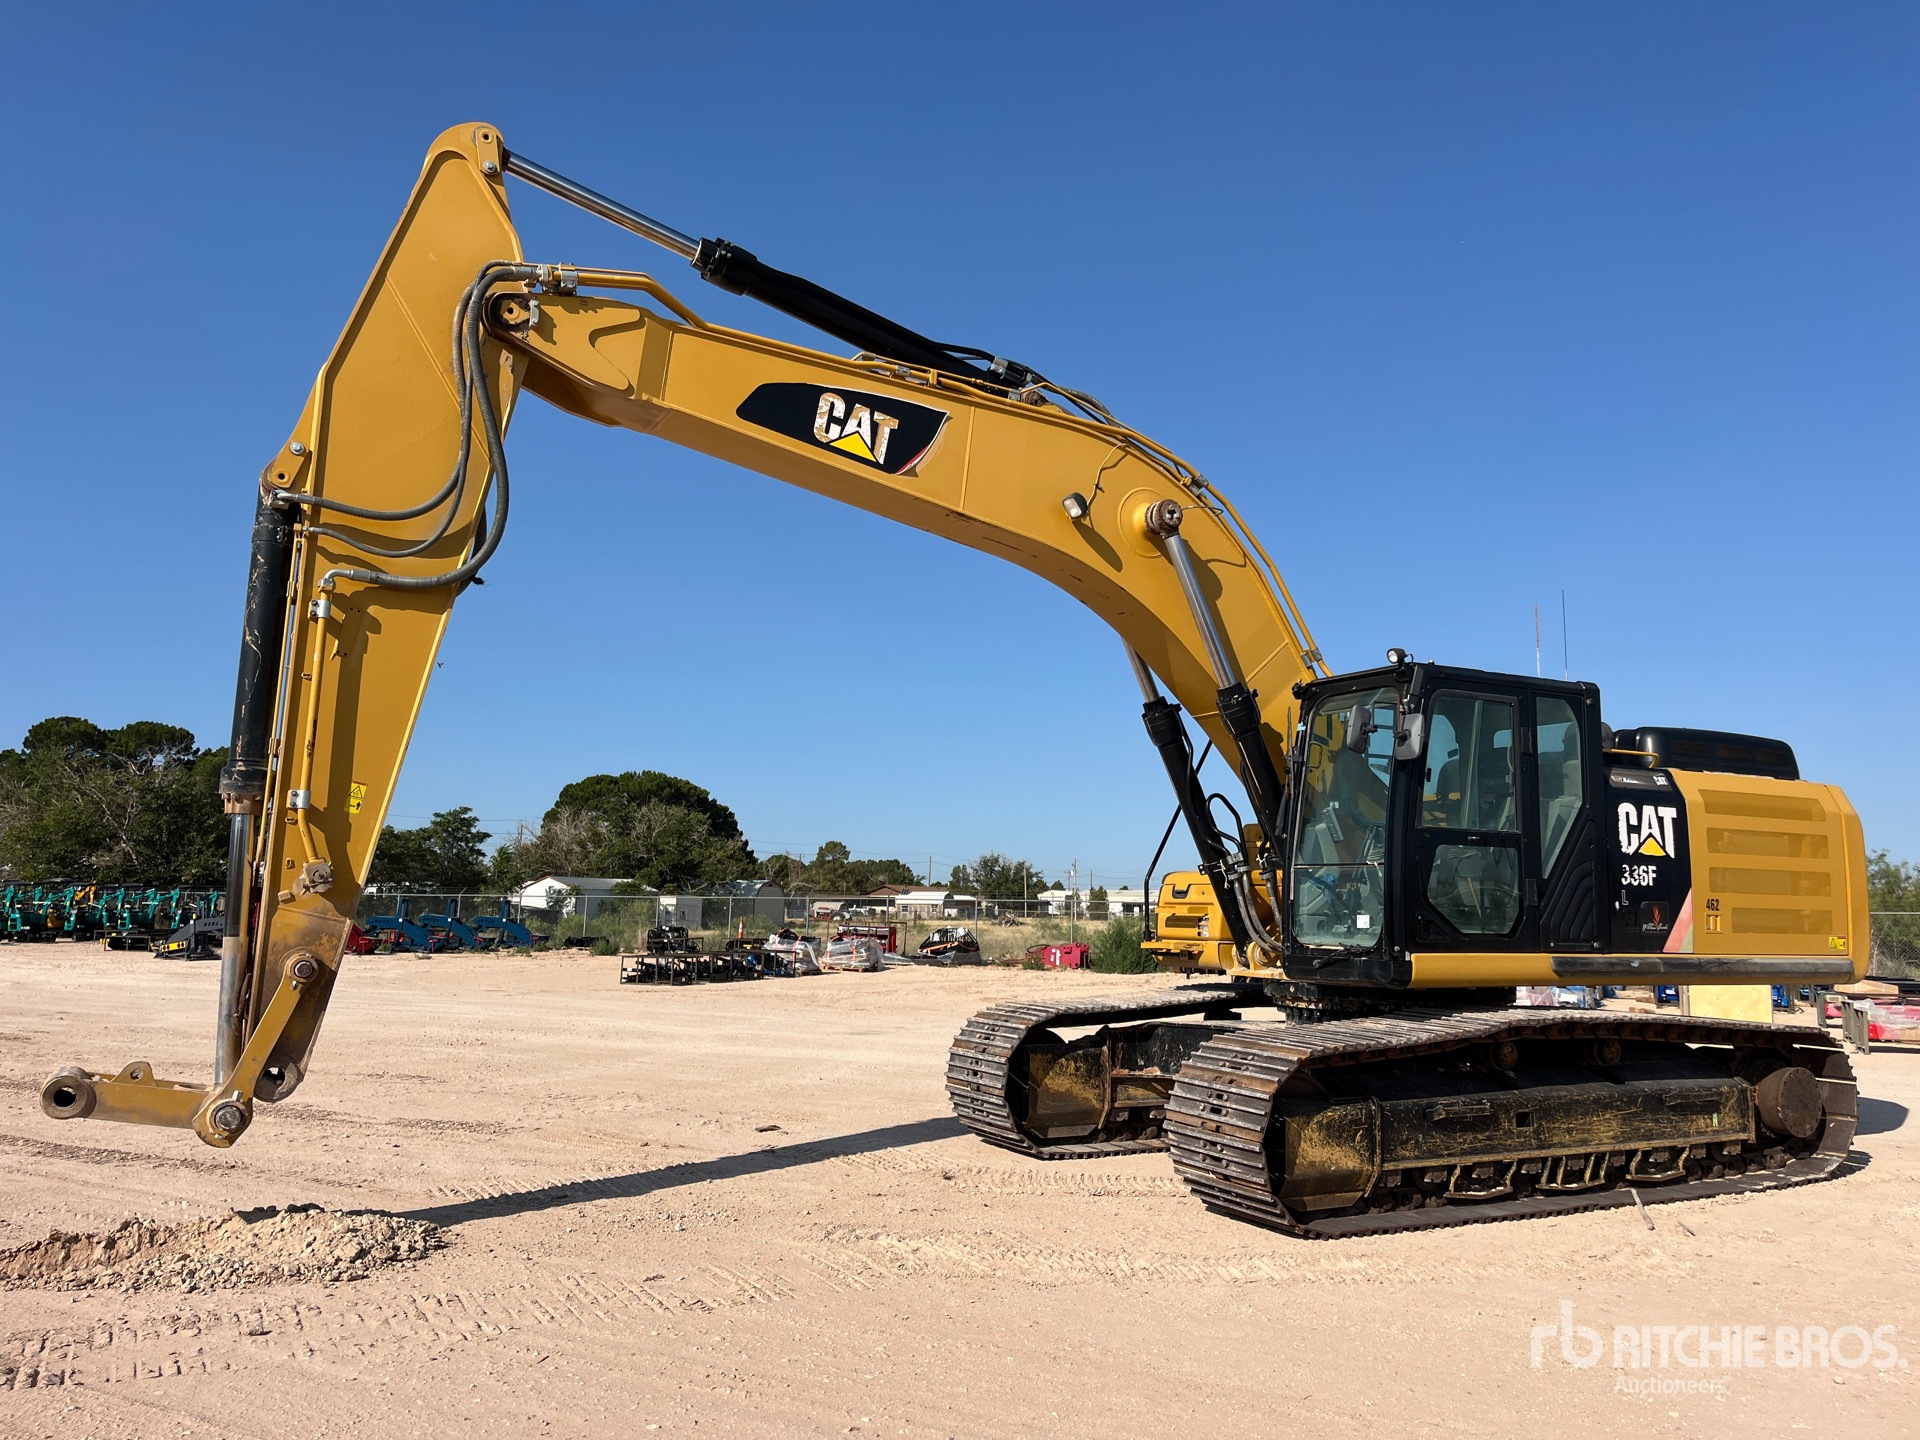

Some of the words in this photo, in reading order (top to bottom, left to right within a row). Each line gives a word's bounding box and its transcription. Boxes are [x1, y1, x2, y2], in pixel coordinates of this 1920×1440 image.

[813, 392, 900, 465] CAT
[1617, 802, 1677, 859] CAT
[1621, 864, 1657, 886] 336F
[1705, 898, 1720, 911] 462
